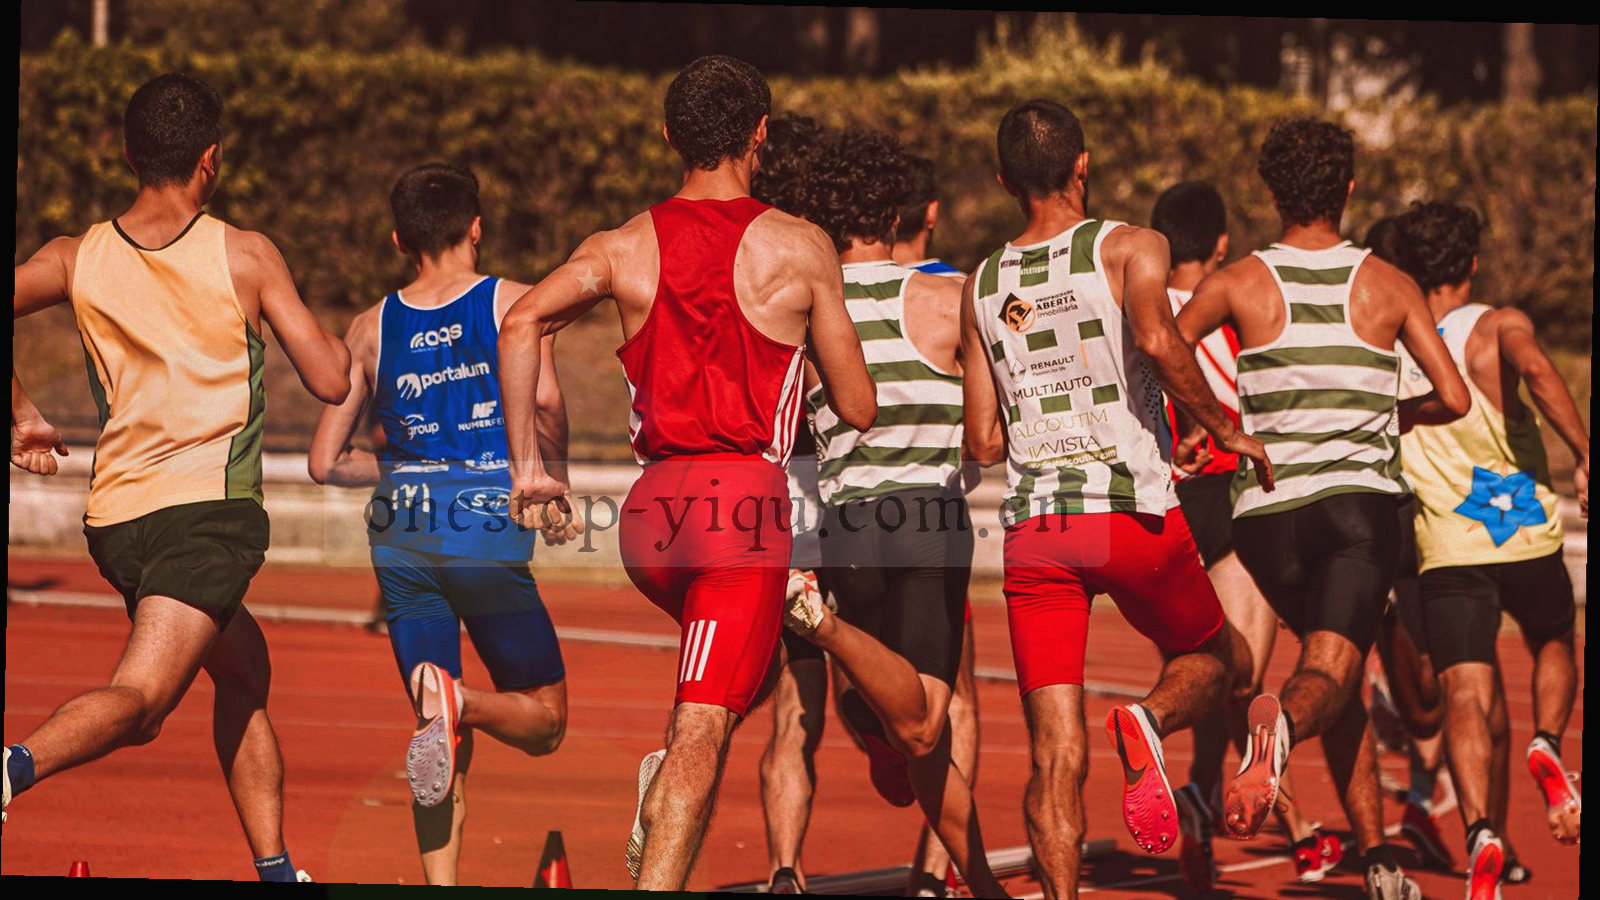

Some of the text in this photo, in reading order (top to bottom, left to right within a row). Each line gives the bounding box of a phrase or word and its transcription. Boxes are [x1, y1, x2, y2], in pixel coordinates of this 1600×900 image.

[1035, 294, 1077, 311] ABERTA
[1030, 355, 1075, 371] RENAULT
[420, 361, 490, 390] portalum
[1012, 375, 1093, 402] MULTIAUTO
[407, 422, 440, 441] group
[457, 417, 505, 431] NUMERFE
[1013, 408, 1108, 442] ALCOUTIM
